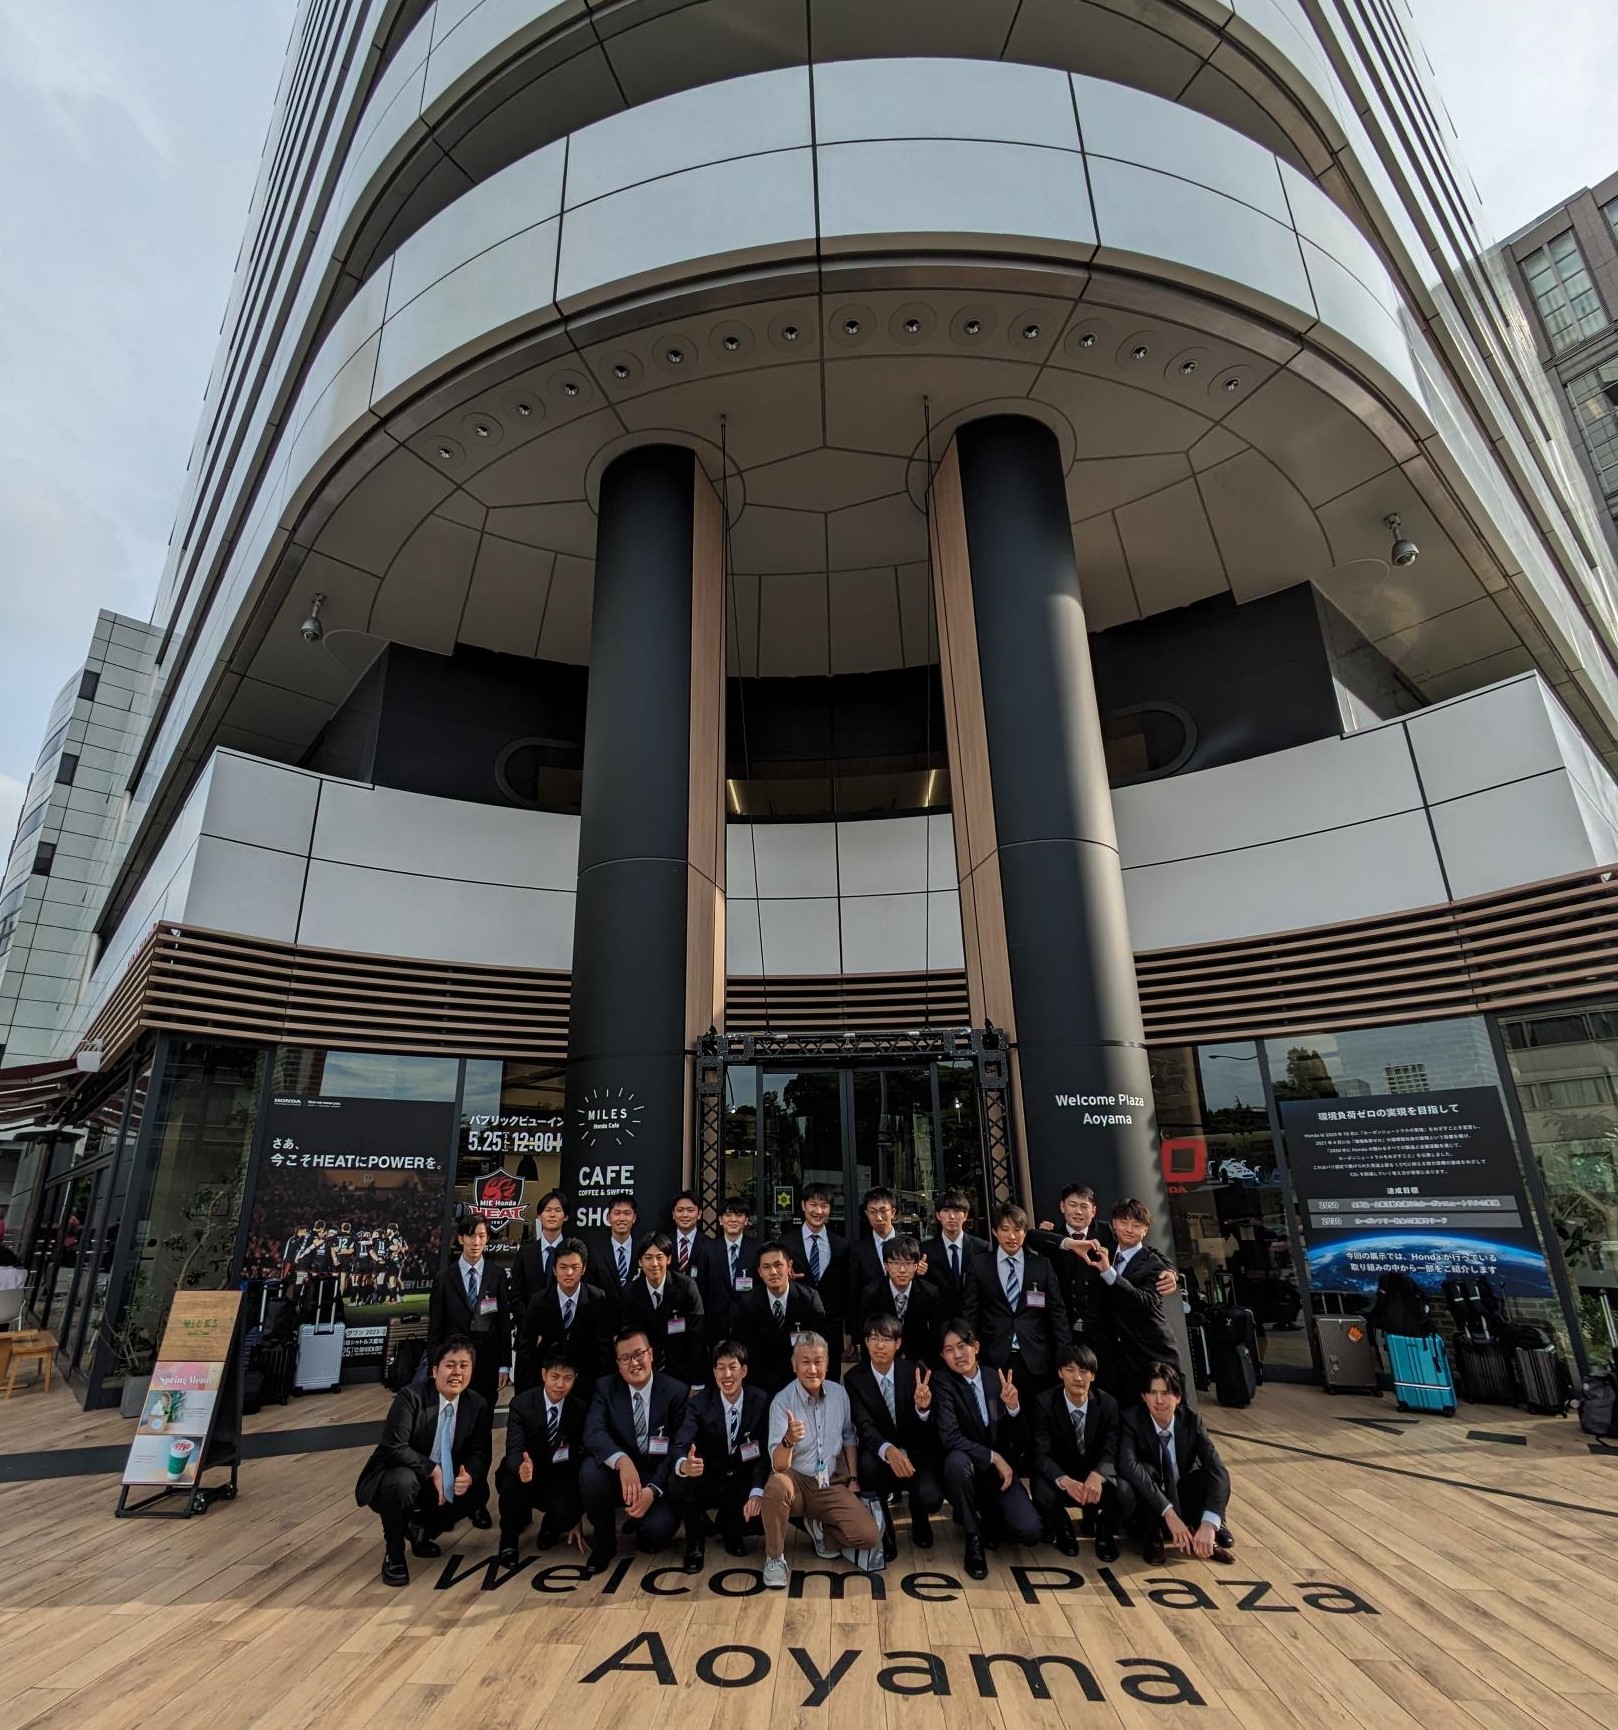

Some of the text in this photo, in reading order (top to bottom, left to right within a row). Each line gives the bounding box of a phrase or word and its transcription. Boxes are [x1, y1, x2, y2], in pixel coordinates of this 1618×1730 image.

[1055, 1093, 1145, 1107] Welcome Plaza
[588, 1108, 627, 1121] MILES
[1083, 1112, 1133, 1128] Aoyama
[1317, 1103, 1460, 1121] 環境負荷ゼロの実現を目指して
[272, 1137, 300, 1150] さあ、
[467, 1130, 502, 1152] 5.25
[270, 1152, 442, 1170] 今こそHEATにPOWERを。
[578, 1165, 635, 1186] CAFE
[471, 1206, 524, 1219] HEAT
[576, 1207, 611, 1227] SHO
[434, 1554, 1382, 1616] Welcome Plaza
[578, 1631, 1208, 1707] Aoyama
